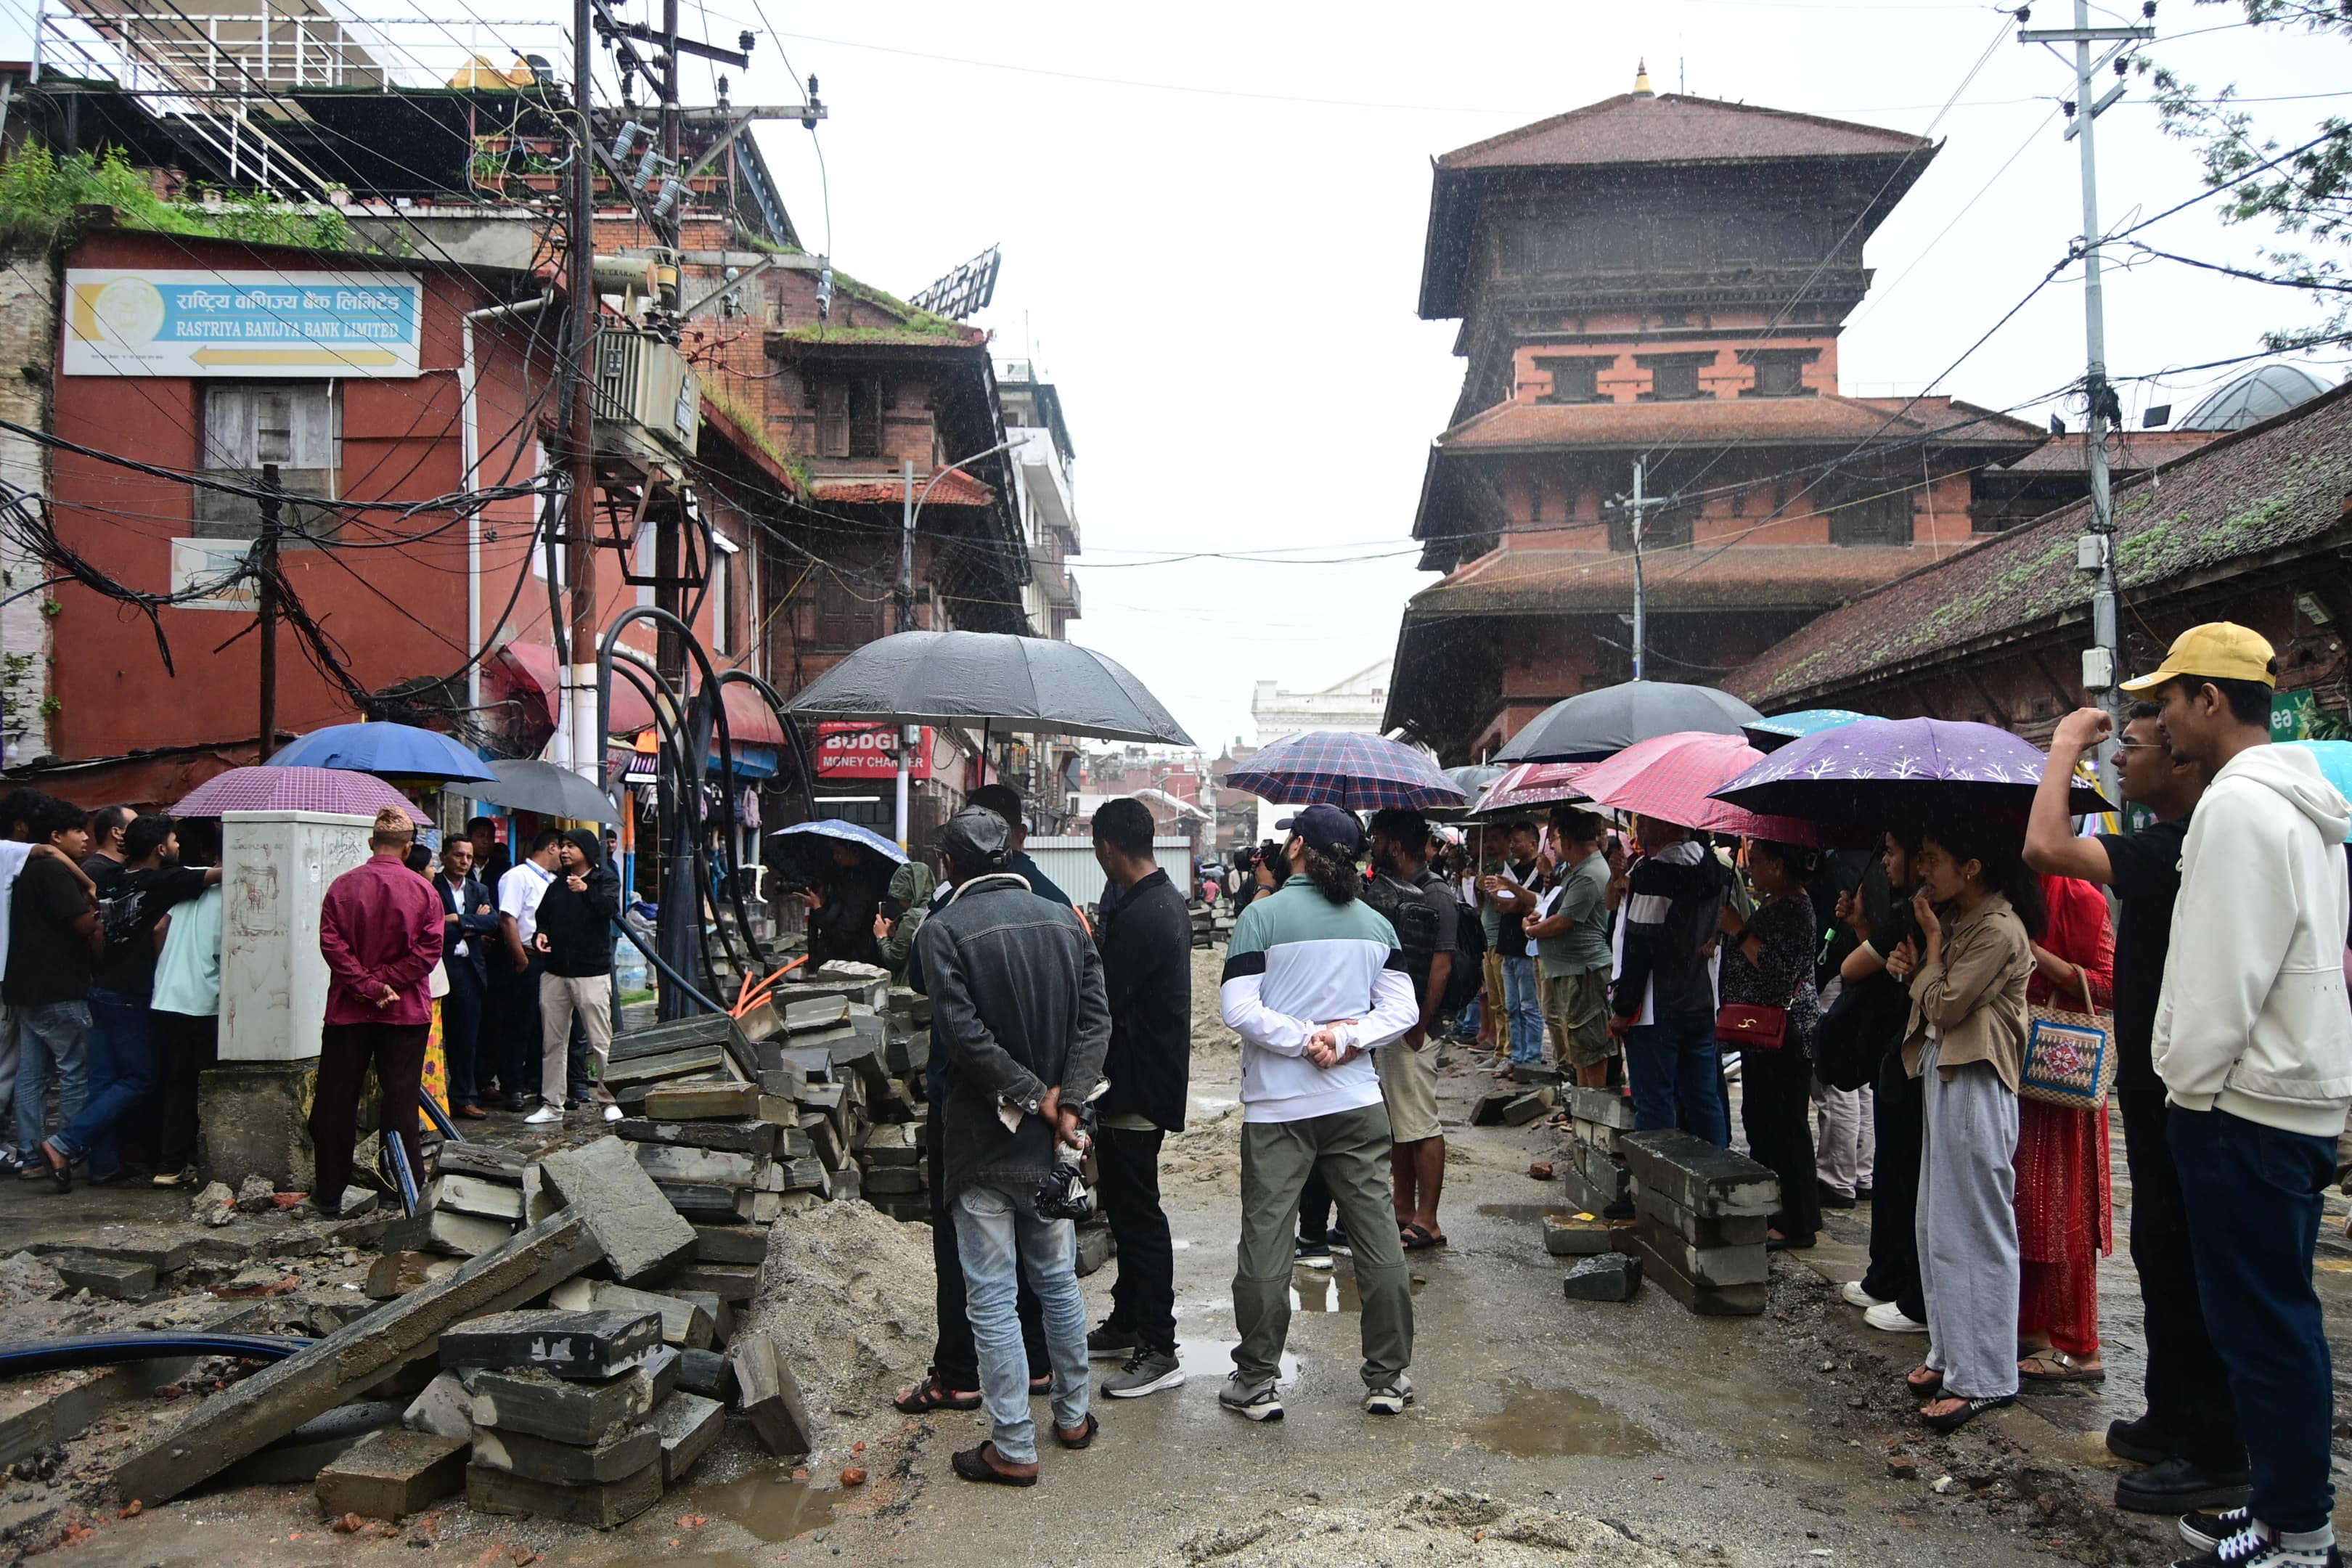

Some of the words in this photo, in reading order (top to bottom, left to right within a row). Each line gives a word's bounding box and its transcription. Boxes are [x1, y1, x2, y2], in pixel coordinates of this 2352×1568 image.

[176, 290, 231, 312] राष्ट्रिय
[235, 290, 298, 309] वाणिज्य
[303, 291, 331, 309] बैंक
[336, 292, 399, 310] लिमिटेड
[176, 321, 241, 336] RASTRIYA
[245, 322, 300, 337] BANIJYA
[304, 322, 340, 338] BANK
[343, 322, 399, 338] LIMITED
[2271, 709, 2292, 729] ea
[823, 756, 865, 767] MONEY
[867, 757, 923, 767] CHANER
